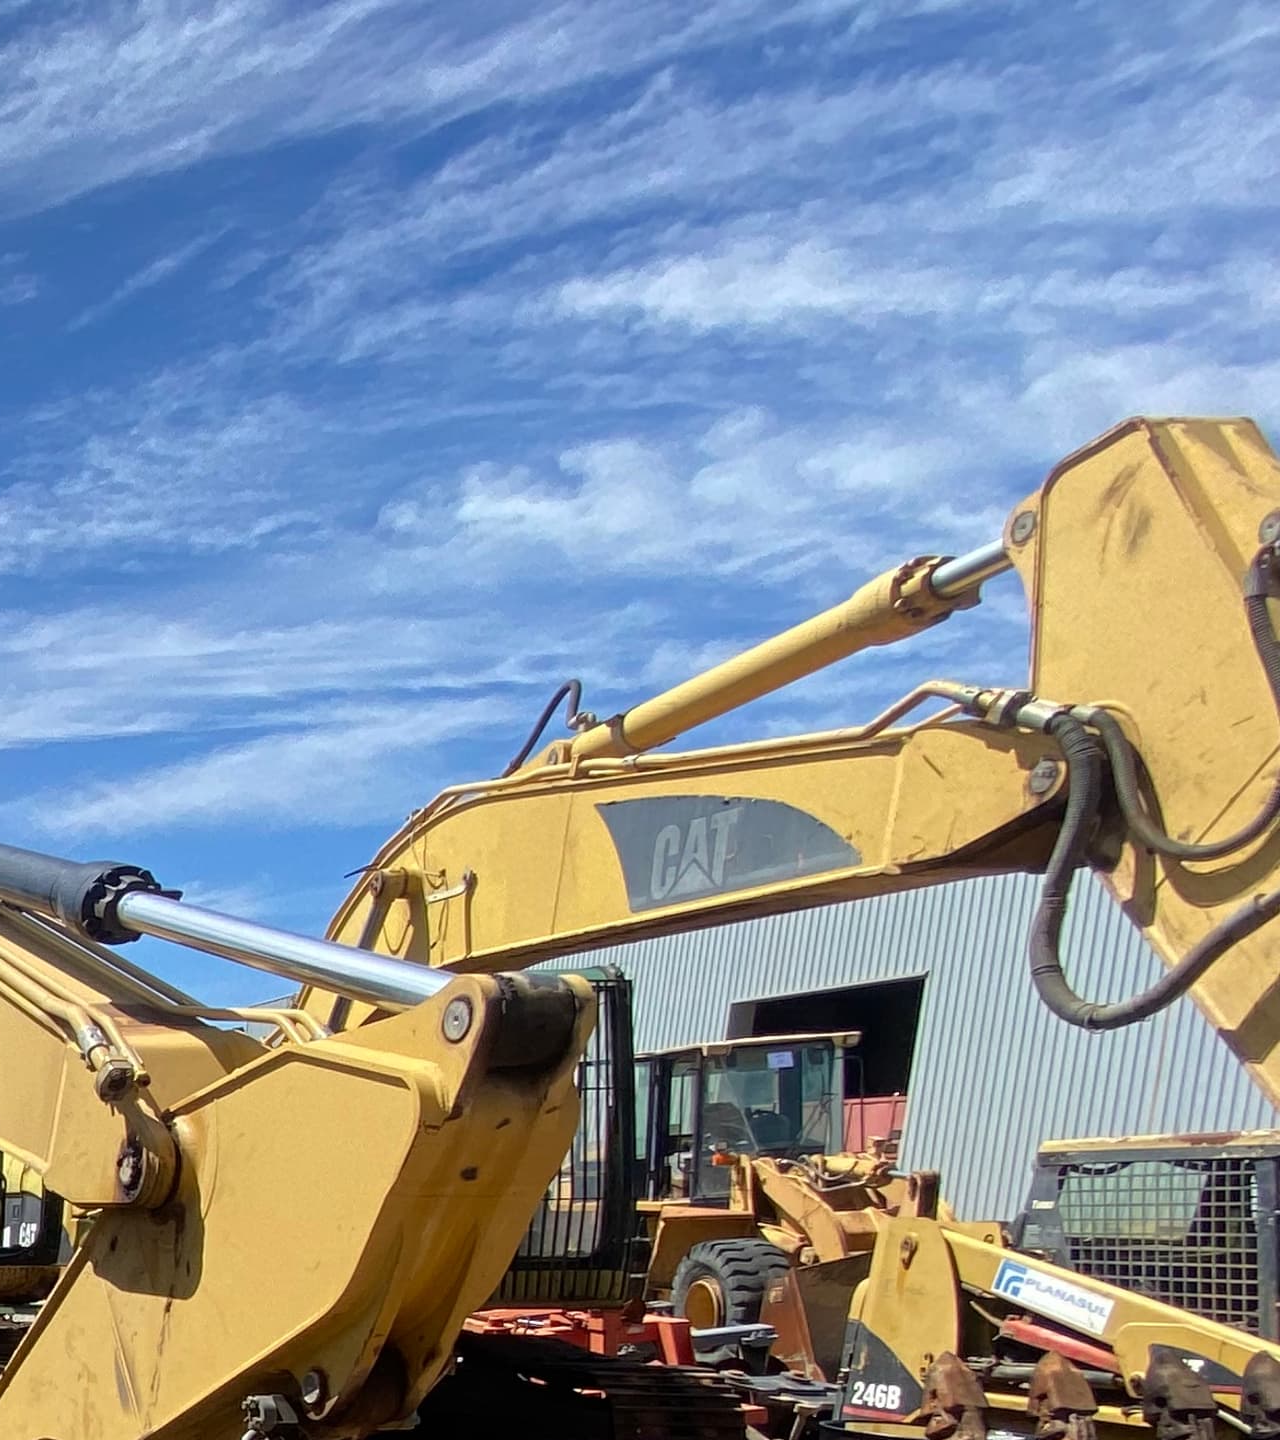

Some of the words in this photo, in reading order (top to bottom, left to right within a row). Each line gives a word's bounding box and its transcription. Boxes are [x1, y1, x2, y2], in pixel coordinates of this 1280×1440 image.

[651, 807, 744, 899] CAT
[1024, 1278, 1107, 1318] PLANASUL
[851, 1380, 901, 1409] 246B
